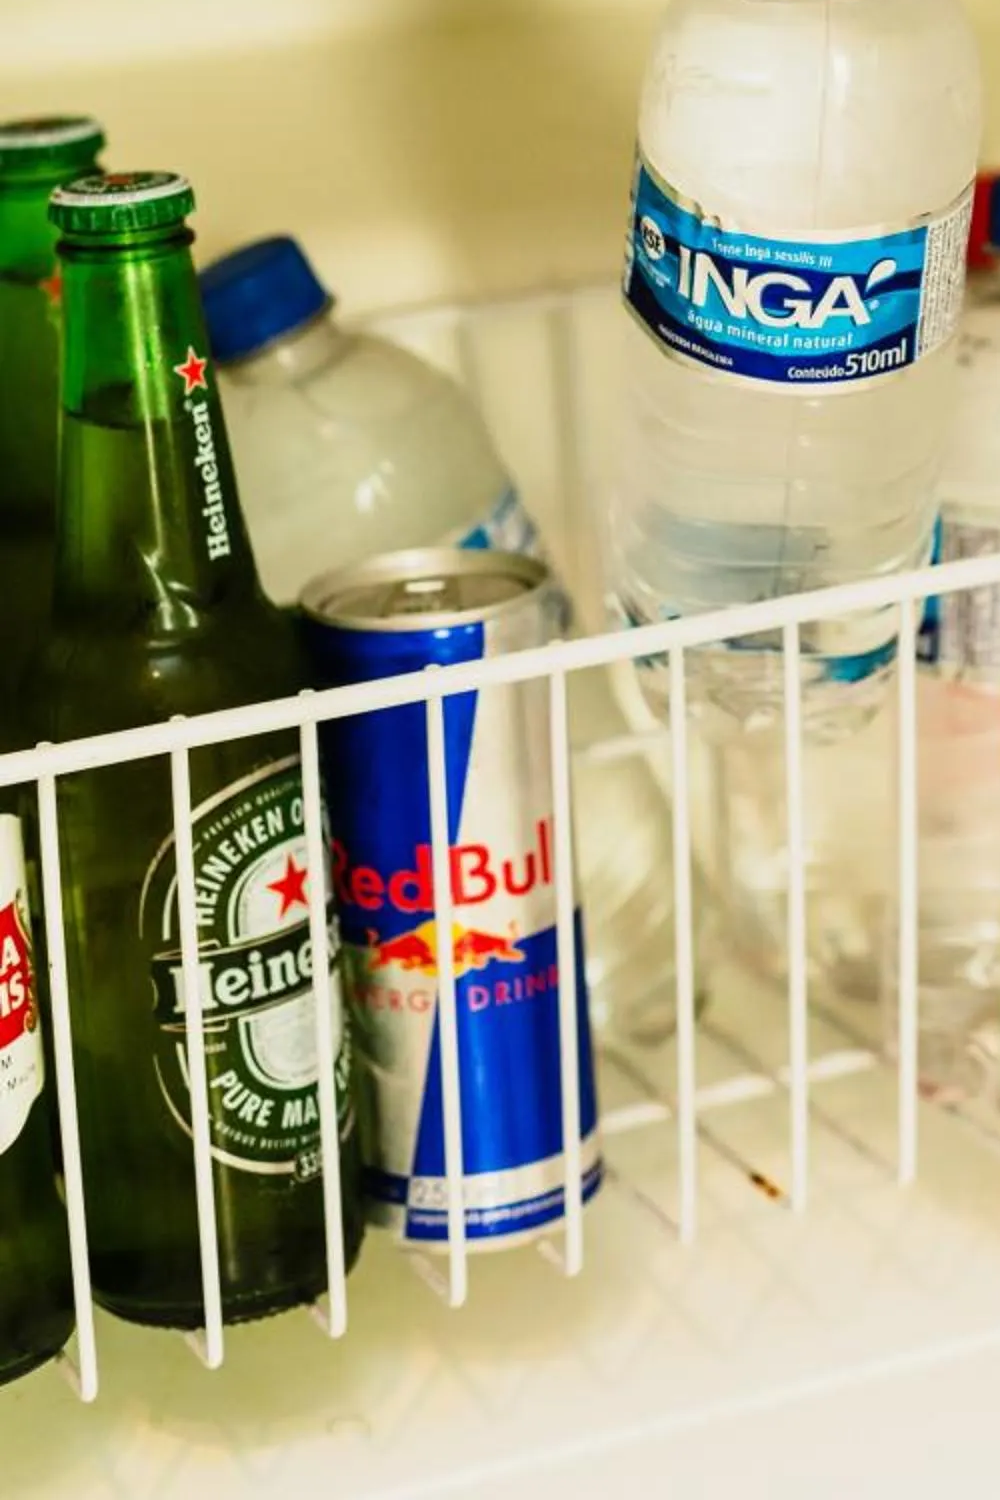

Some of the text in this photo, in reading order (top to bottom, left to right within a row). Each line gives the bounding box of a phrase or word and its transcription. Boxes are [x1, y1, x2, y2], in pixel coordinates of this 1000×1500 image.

[687, 309, 853, 350] água mineral natural
[787, 337, 907, 380] Conteúdo 510ml
[192, 401, 232, 561] Heineken
[194, 805, 285, 927] HEINEKEN
[449, 819, 556, 906] Bul
[168, 930, 331, 1014] Heine
[210, 1068, 319, 1130] PURE MA
